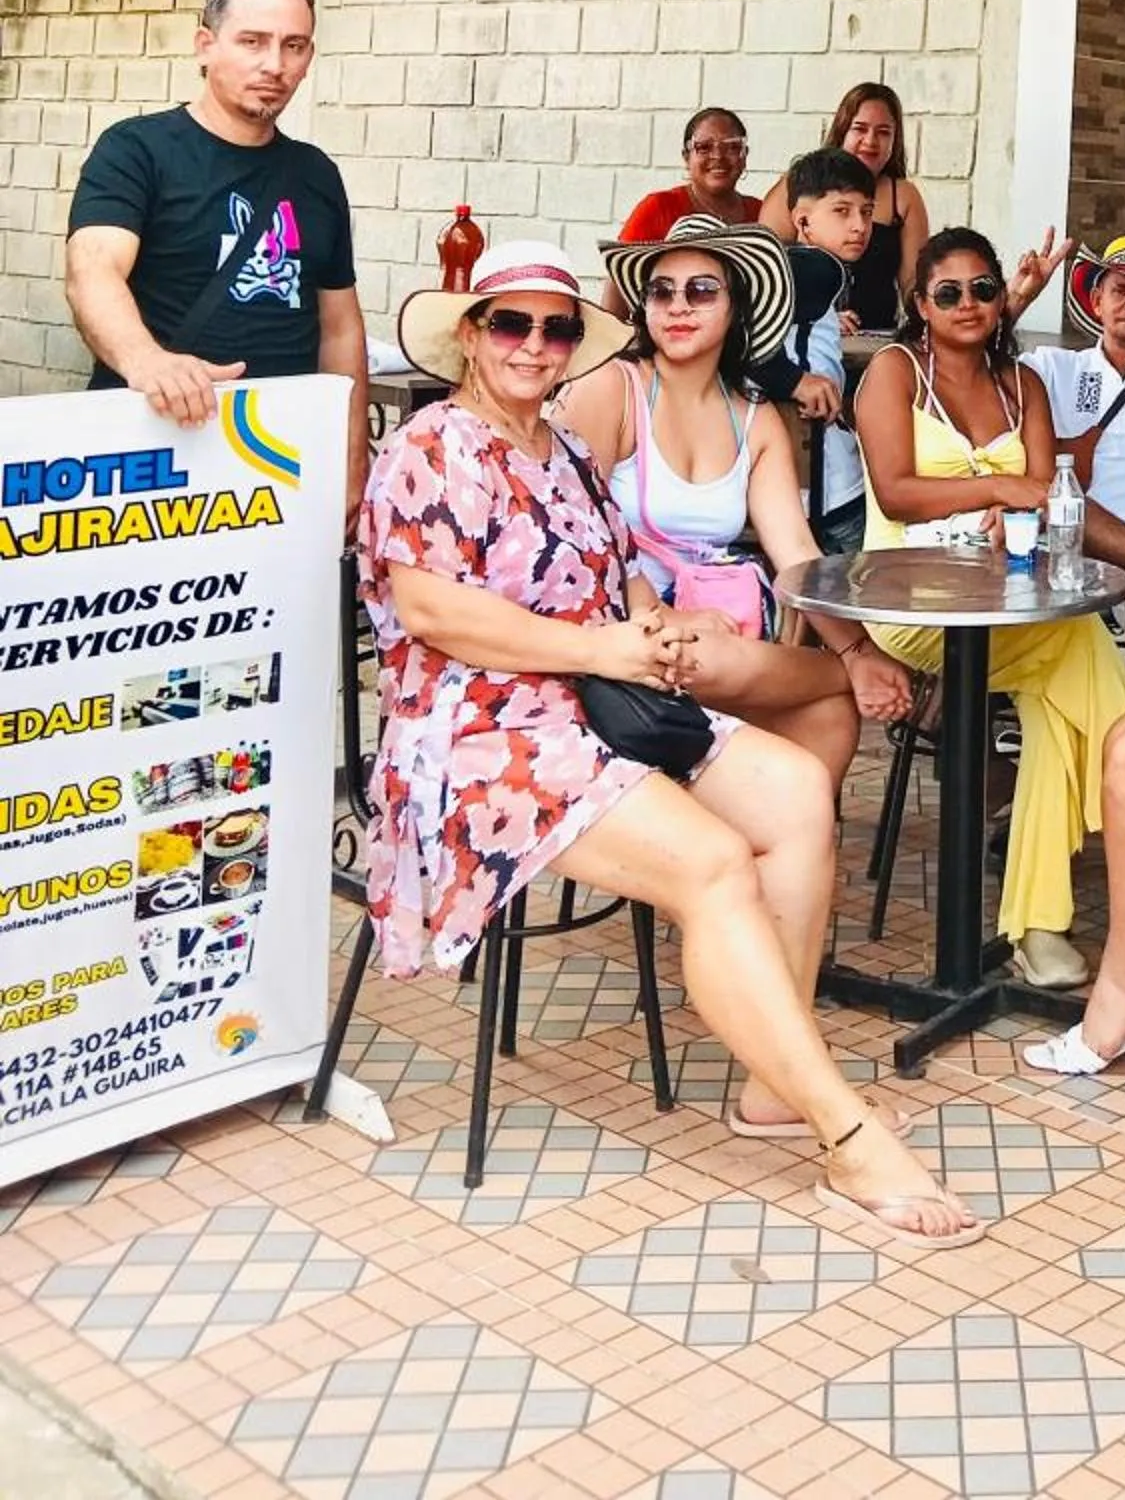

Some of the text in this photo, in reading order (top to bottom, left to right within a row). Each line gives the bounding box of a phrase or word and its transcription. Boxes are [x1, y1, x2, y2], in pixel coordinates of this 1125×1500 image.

[2, 448, 189, 508] HOTEL
[169, 571, 248, 605] CON
[0, 616, 199, 672] ERVICIOS
[0, 693, 115, 747] EDAJE
[0, 813, 127, 851] as,Jugos,Sodas)
[52, 955, 128, 994] PARA
[0, 1096, 53, 1128] CHA
[60, 1085, 88, 1108] LA
[94, 1053, 185, 1096] GUAJIRA
[14, 1072, 54, 1101] 11A
[62, 1036, 162, 1085] #14B-65
